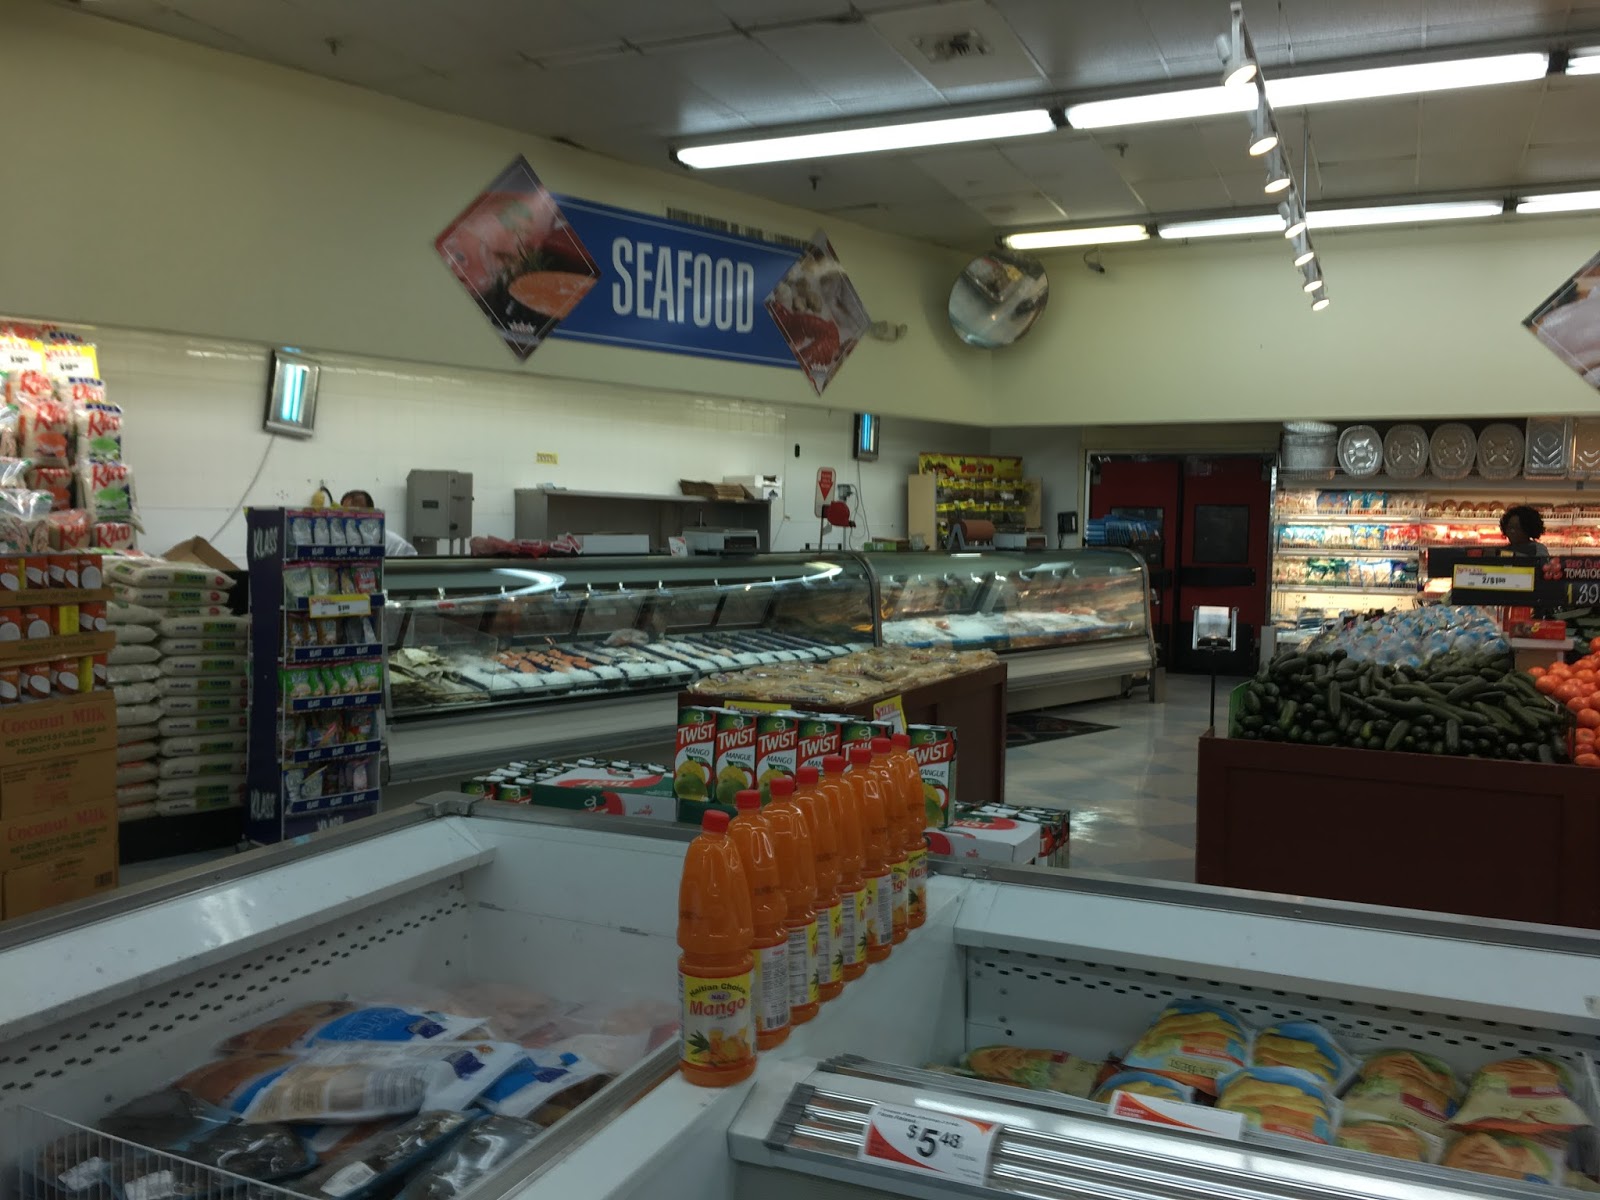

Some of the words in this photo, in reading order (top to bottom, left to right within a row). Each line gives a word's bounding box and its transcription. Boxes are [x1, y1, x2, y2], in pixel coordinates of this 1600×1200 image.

[612, 237, 754, 334] SEAFOOD
[87, 411, 121, 437] Rico
[92, 463, 127, 489] Rico
[96, 523, 131, 549] Rico
[2, 714, 64, 734] Coconut
[73, 704, 105, 724] Milk
[678, 723, 715, 744] TWIST
[717, 727, 755, 750] TWIST
[758, 730, 796, 753] TWIST
[685, 747, 710, 757] MANGO
[725, 752, 752, 761] MANGUE
[798, 734, 838, 758] TWIST
[907, 742, 949, 765] TWIST
[766, 755, 793, 765] MANGO
[689, 984, 718, 997] Haitian
[720, 983, 746, 995] Choice
[689, 997, 746, 1017] Mango
